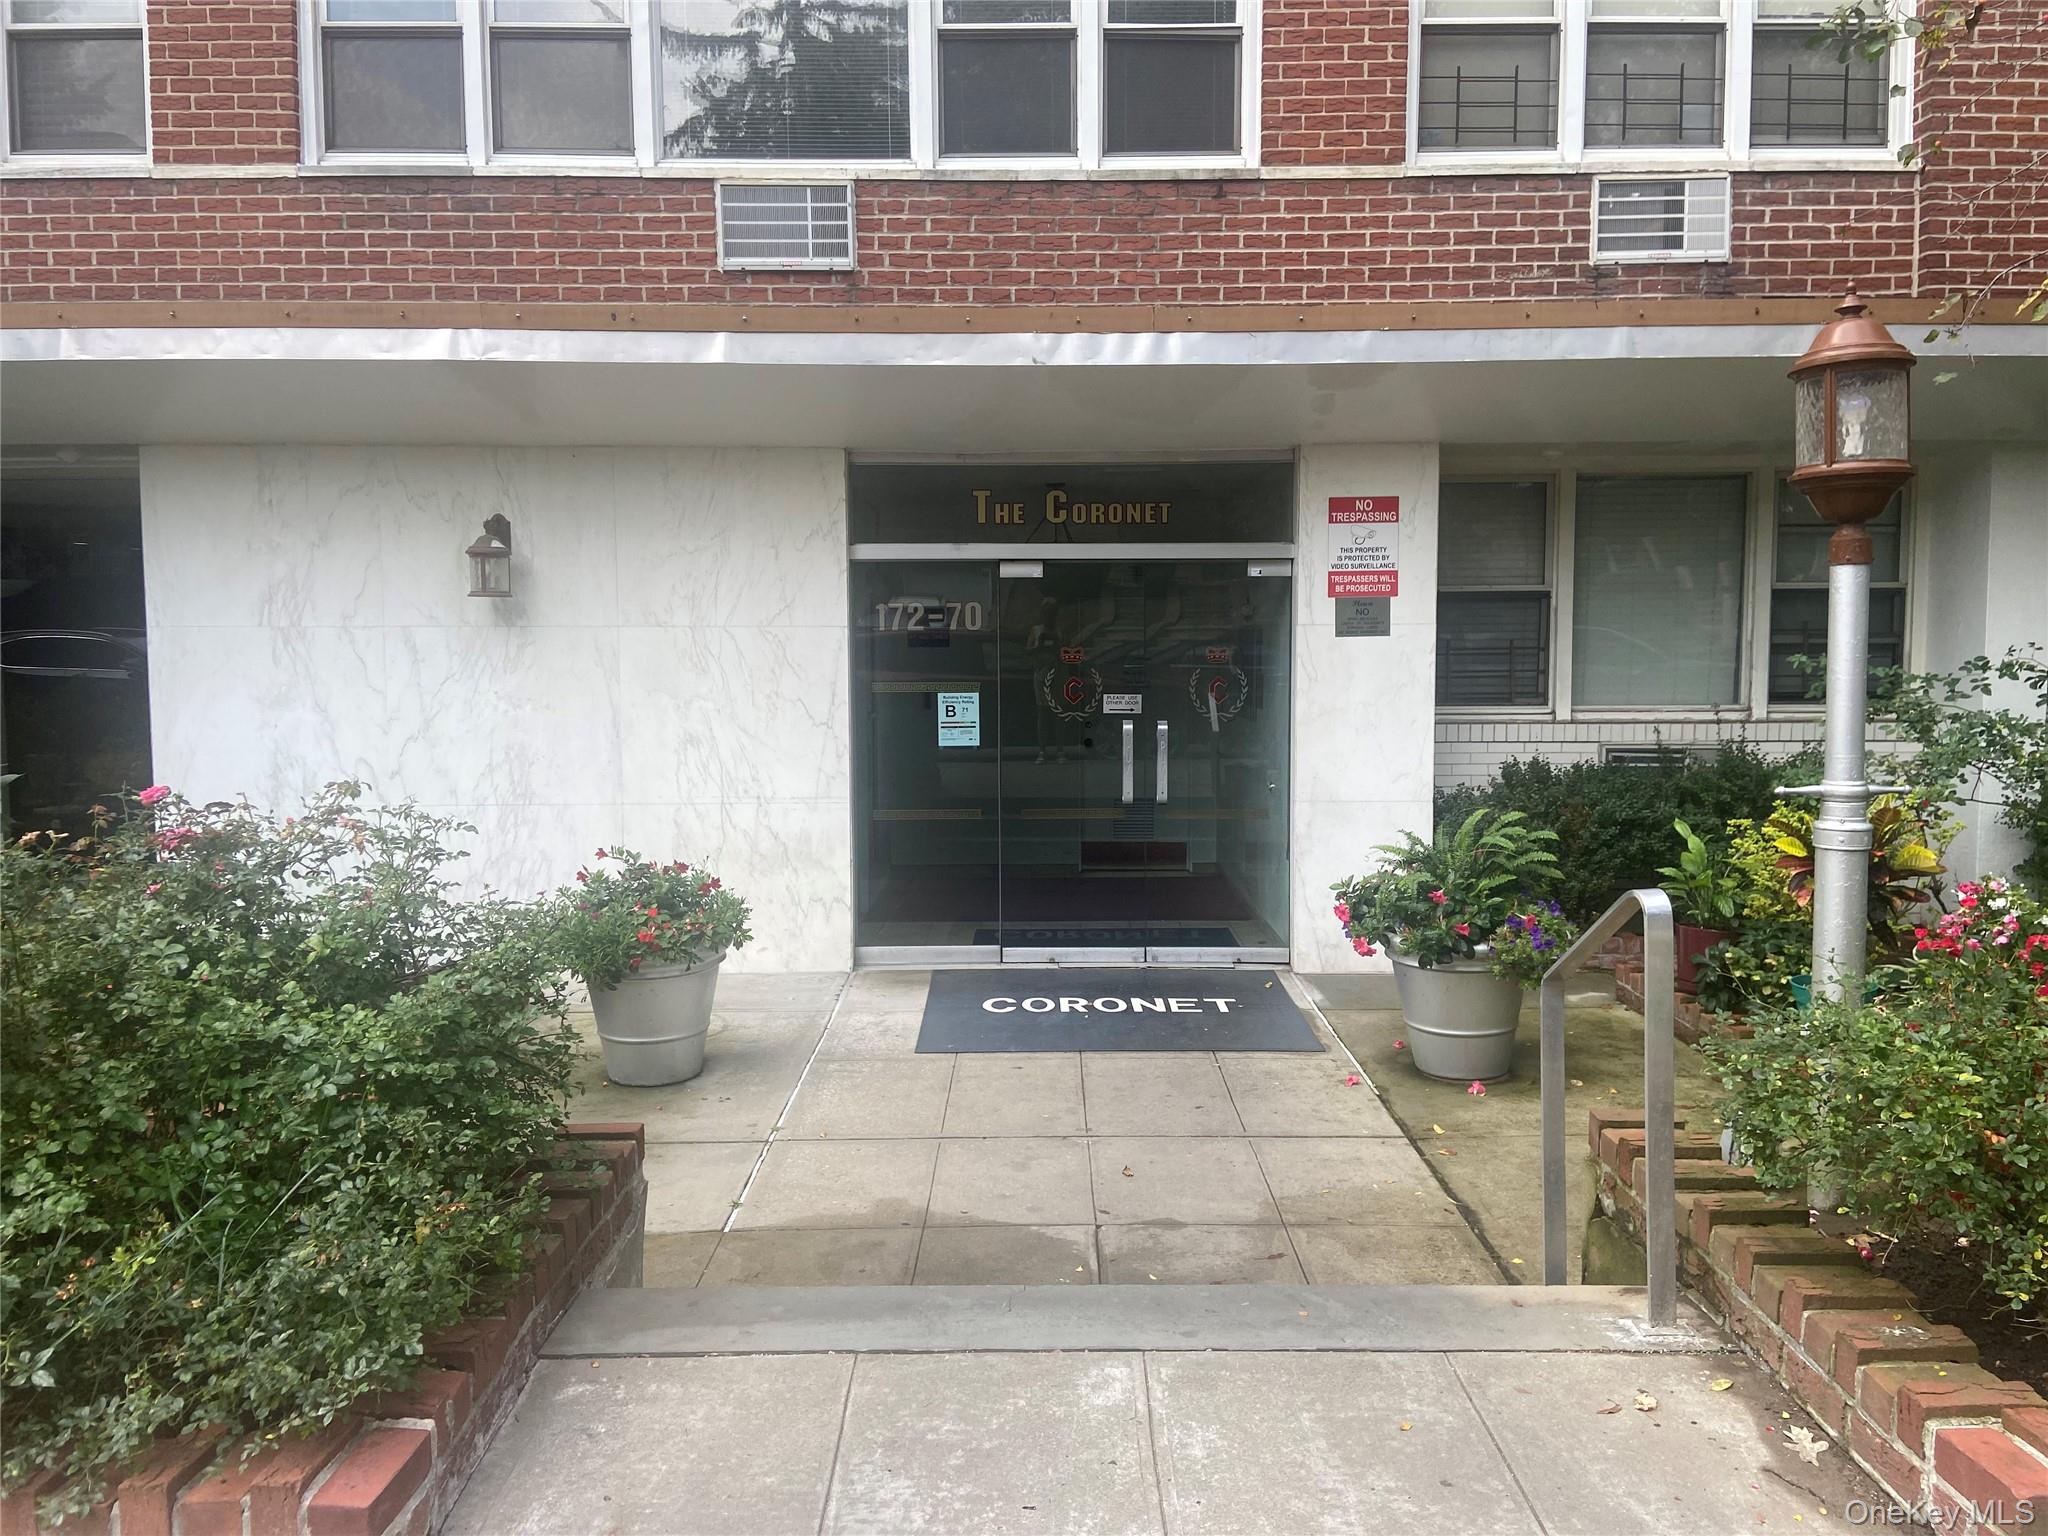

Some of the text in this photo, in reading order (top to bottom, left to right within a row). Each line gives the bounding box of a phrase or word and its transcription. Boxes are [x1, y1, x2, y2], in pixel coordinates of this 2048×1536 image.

[1045, 488, 1172, 525] CORONET
[1355, 499, 1373, 511] NO
[1331, 512, 1397, 522] TRESPASSING
[1354, 546, 1388, 554] PROPERTY
[1350, 562, 1396, 570] SURVEILLANCE
[1331, 574, 1396, 583] TRESPASSERS WILL
[1345, 584, 1391, 592] PROSECUTED
[875, 601, 983, 632] 172-70
[1355, 607, 1370, 617] NO
[946, 705, 956, 717] B
[982, 997, 1236, 1013] CORONET
